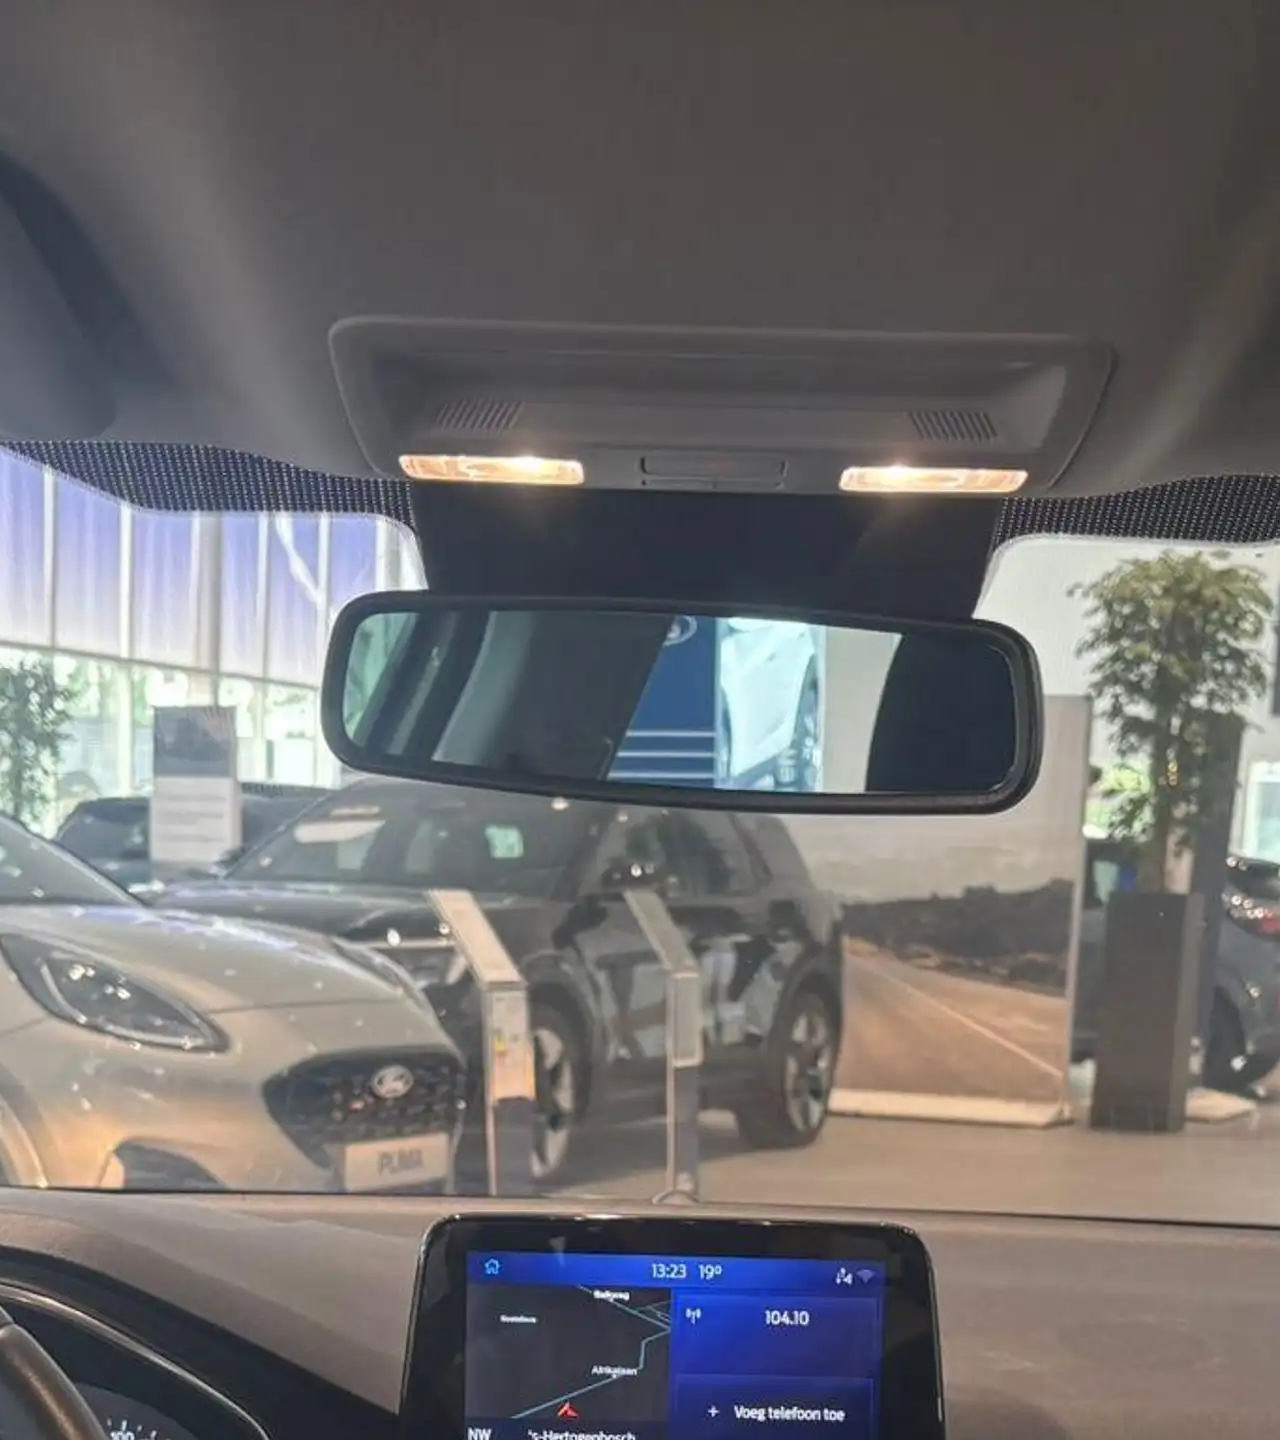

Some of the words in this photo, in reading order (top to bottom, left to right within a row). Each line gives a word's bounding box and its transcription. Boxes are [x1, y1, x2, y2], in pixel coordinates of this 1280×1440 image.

[652, 1263, 687, 1279] 13:23
[765, 1310, 810, 1326] 104.10
[734, 1405, 765, 1422] Voeg
[768, 1406, 822, 1421] telefoon
[824, 1408, 846, 1422] toe
